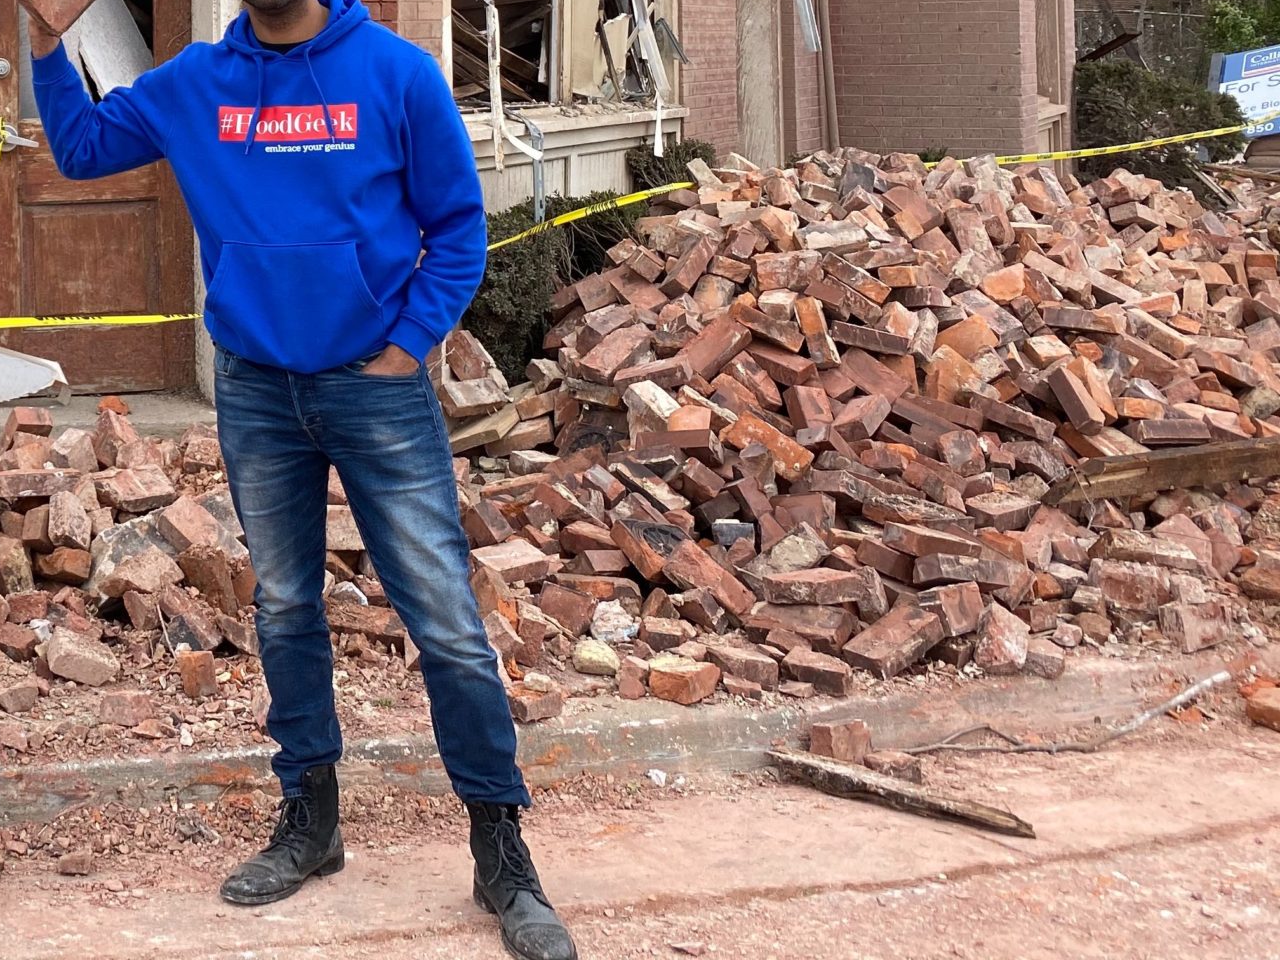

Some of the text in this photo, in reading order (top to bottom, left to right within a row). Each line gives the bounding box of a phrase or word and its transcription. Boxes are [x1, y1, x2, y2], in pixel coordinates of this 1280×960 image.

[1225, 81, 1260, 94] For
[264, 141, 355, 154] embrace your genius
